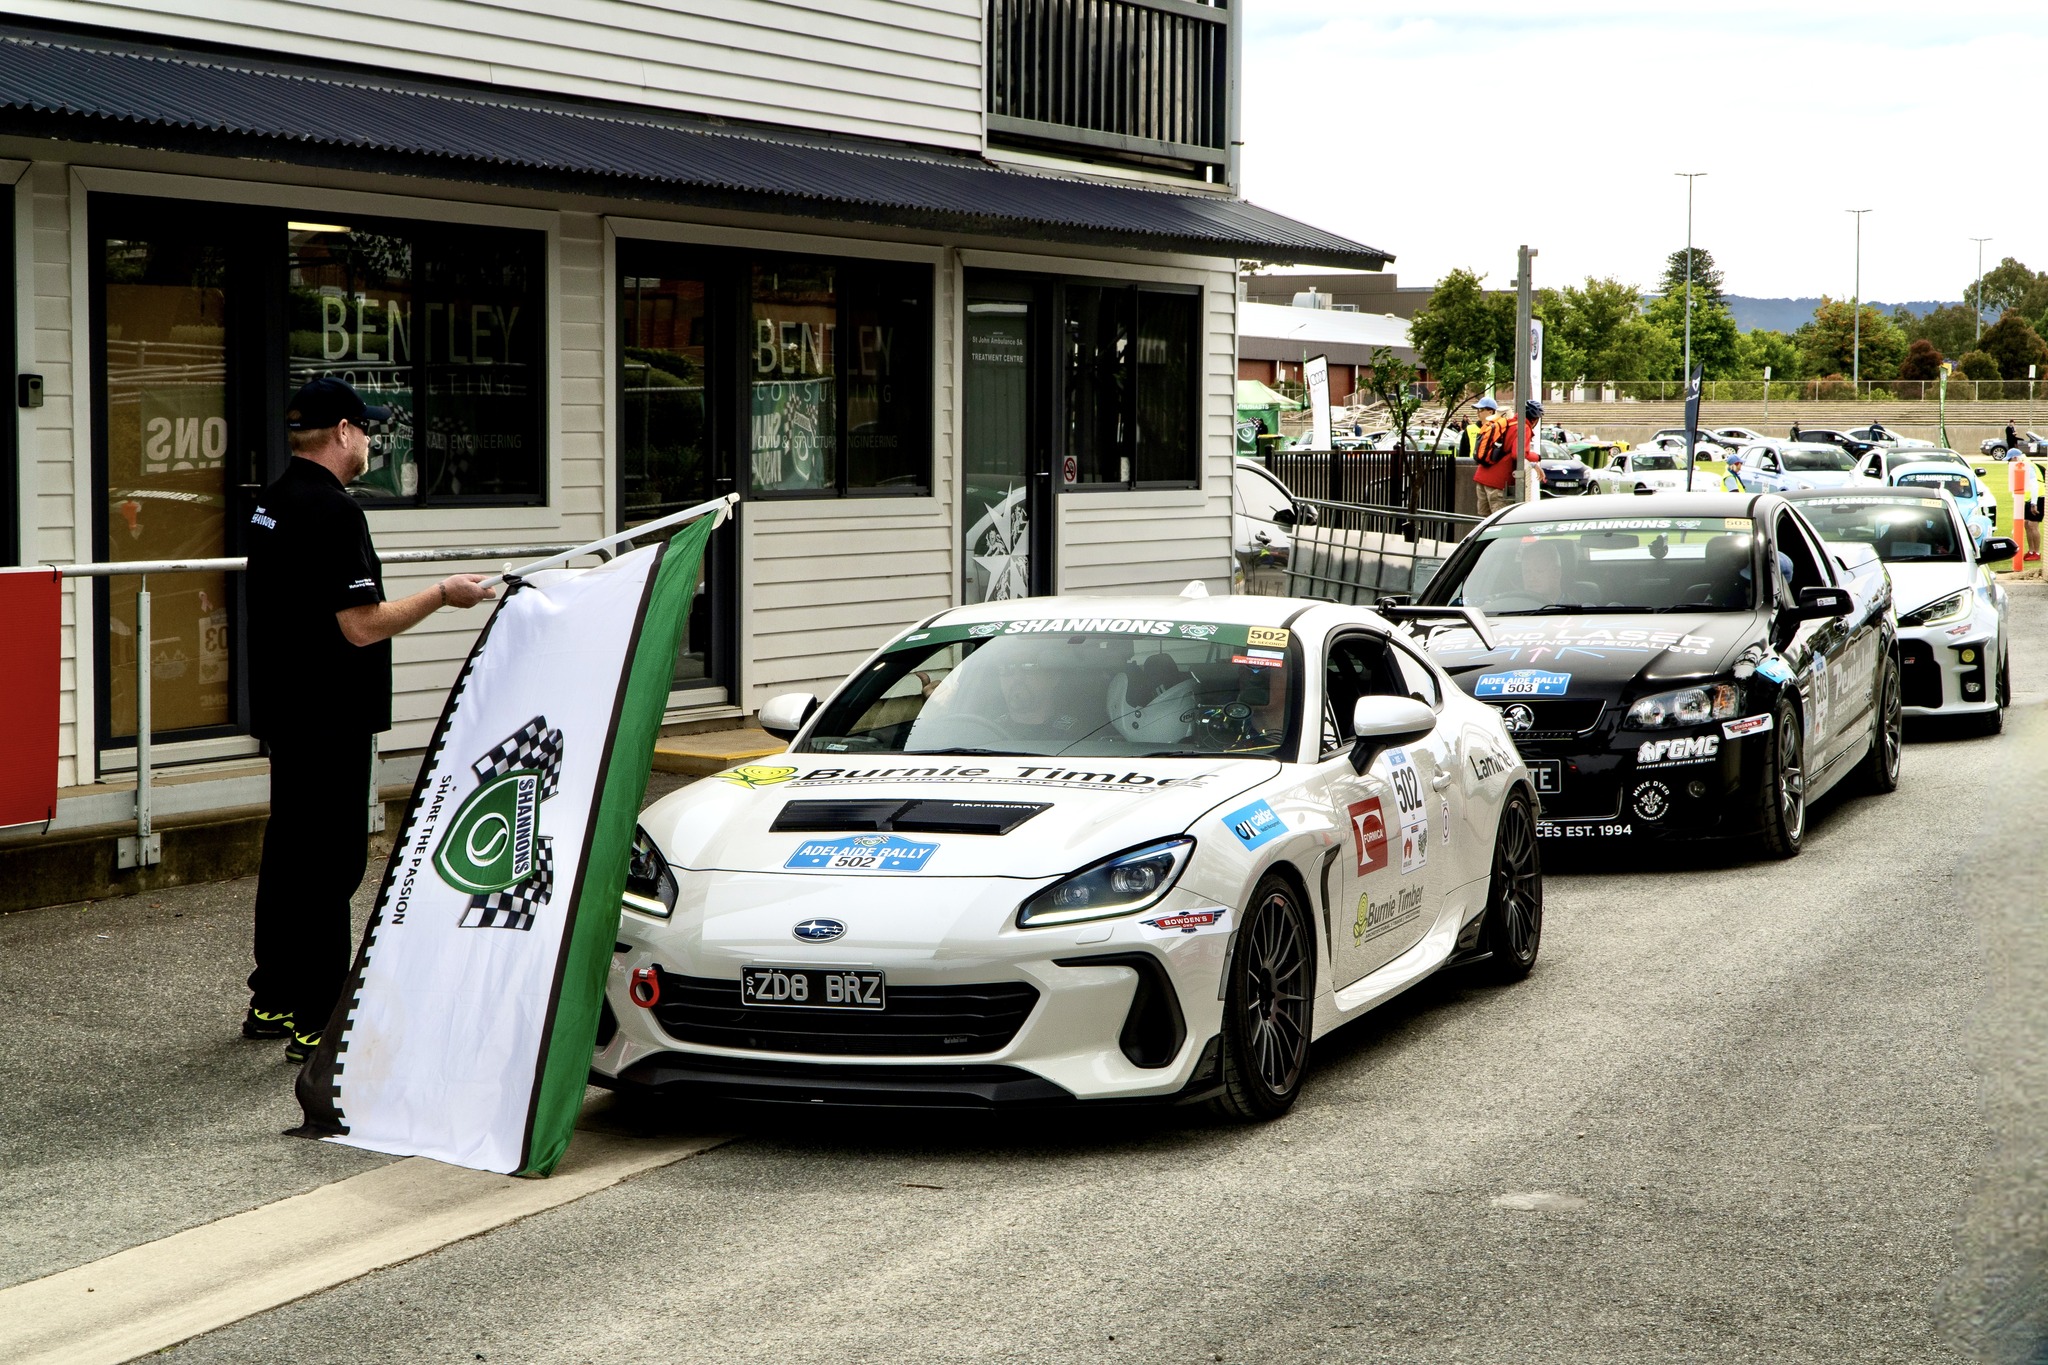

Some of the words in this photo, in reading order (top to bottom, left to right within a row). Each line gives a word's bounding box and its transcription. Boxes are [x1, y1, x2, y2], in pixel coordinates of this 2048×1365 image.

[322, 297, 520, 363] BENTLEY
[756, 319, 894, 376] BENTEY
[971, 352, 1002, 361] TREATMENT
[1003, 355, 1024, 363] CENTRE
[451, 434, 522, 450] ENGINEERING
[1808, 497, 1894, 506] SHANNONS
[1556, 519, 1672, 532] SHANNONS
[1004, 618, 1175, 635] SHANNONS
[1250, 630, 1287, 642] 502
[1554, 629, 1716, 648] LASER
[1472, 638, 1570, 649] BASTING
[1575, 639, 1708, 655] SPECIALISTS
[1480, 677, 1531, 685] ADELAIDE
[1532, 676, 1567, 685] RALLY
[1507, 684, 1534, 693] 503
[800, 765, 989, 781] Burnie
[1529, 768, 1552, 790] TE
[1391, 767, 1422, 814] 502
[1632, 780, 1650, 797] MIKE
[1653, 780, 1670, 796] DYER
[425, 774, 453, 825] SHARE
[513, 778, 536, 875] SHANNONS
[1566, 826, 1595, 838] EST.
[1598, 824, 1632, 836] 1994
[414, 825, 435, 855] THE
[1363, 828, 1384, 845] FORMICA
[799, 845, 879, 858] ADELAIDE
[880, 847, 931, 859] RALLY
[834, 857, 876, 868] 502
[391, 857, 423, 925] PASSION
[1367, 895, 1396, 928] Burnie
[1398, 884, 1424, 915] Timber
[1164, 915, 1208, 926] BOWDEN'S
[754, 972, 808, 1001] ZD8
[825, 974, 881, 1004] BRZ
